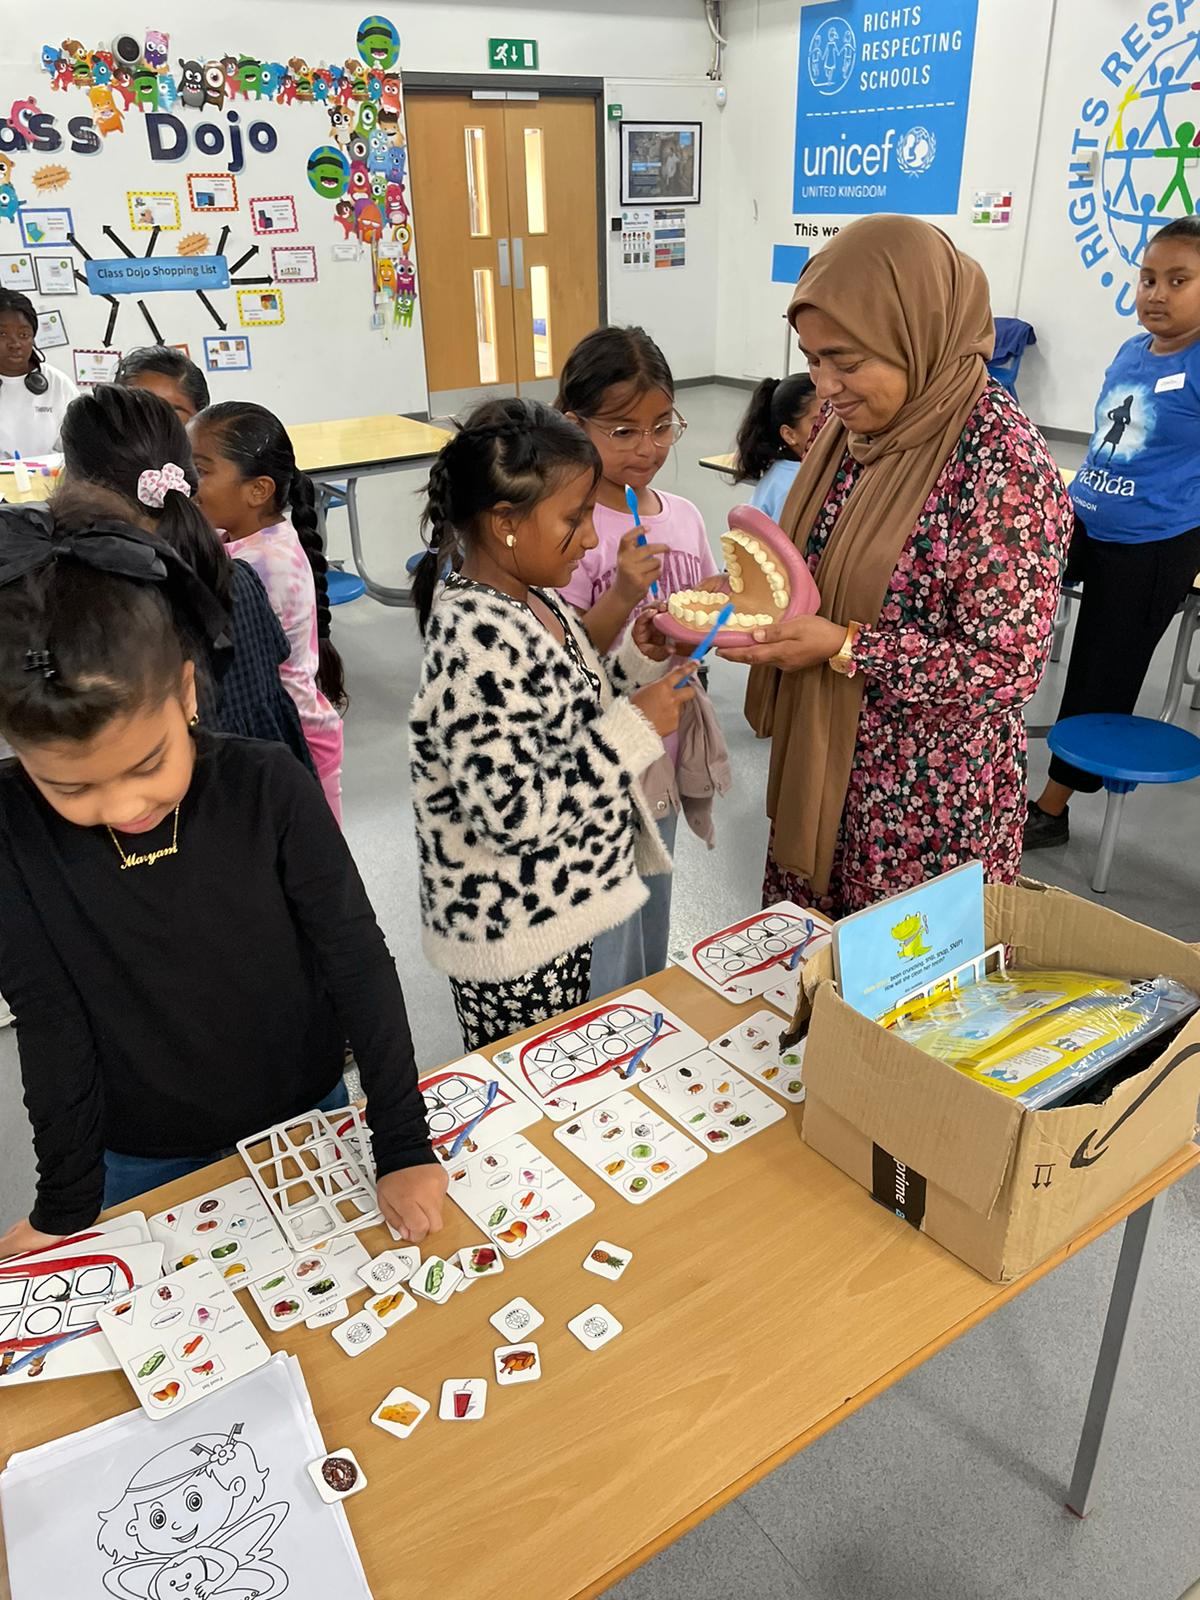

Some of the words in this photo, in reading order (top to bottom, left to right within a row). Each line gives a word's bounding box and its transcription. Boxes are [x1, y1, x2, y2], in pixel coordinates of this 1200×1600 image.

[863, 5, 921, 33] RIGHTS
[861, 30, 962, 62] RESPECTING
[859, 64, 931, 91] SCHOOLS
[144, 110, 278, 173] Dojo
[803, 128, 896, 177] unicef
[801, 185, 837, 198] UNITED
[838, 185, 887, 198] KINGDOM
[794, 223, 819, 237] This
[97, 269, 124, 279] Class
[126, 267, 150, 279] Dojo
[153, 265, 199, 277] Shopping
[201, 264, 217, 274] List
[1072, 496, 1098, 512] LONDON
[893, 1157, 910, 1205] prime
